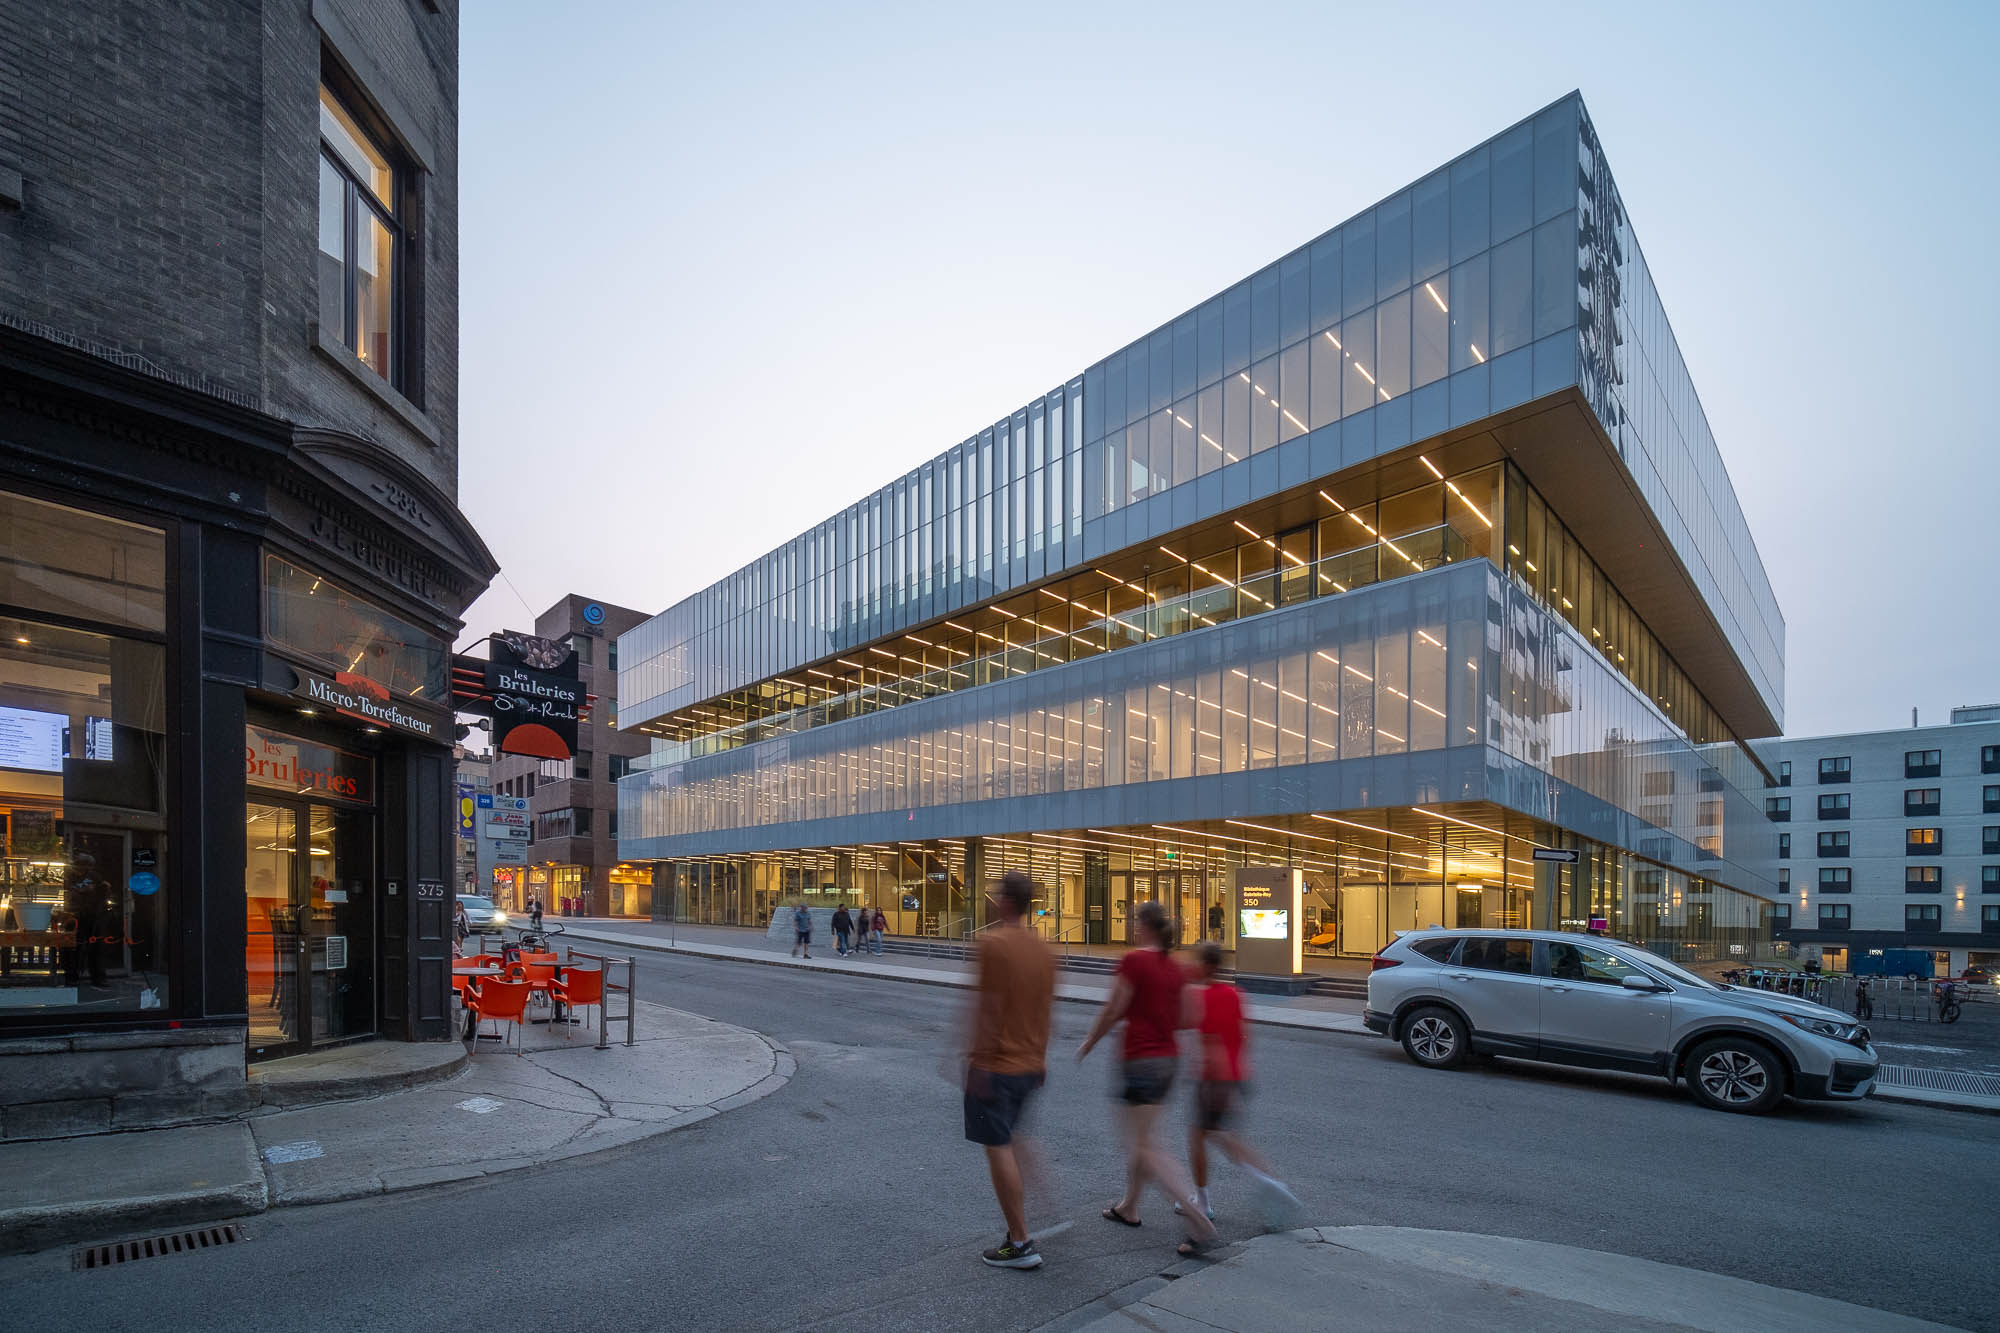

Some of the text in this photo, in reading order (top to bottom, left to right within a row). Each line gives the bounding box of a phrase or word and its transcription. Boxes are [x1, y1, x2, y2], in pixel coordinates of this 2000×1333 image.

[514, 669, 528, 681] les
[498, 674, 575, 701] Bruleries
[309, 678, 432, 734] Micro-Torréfacteur
[263, 738, 281, 755] les
[418, 883, 444, 896] 375
